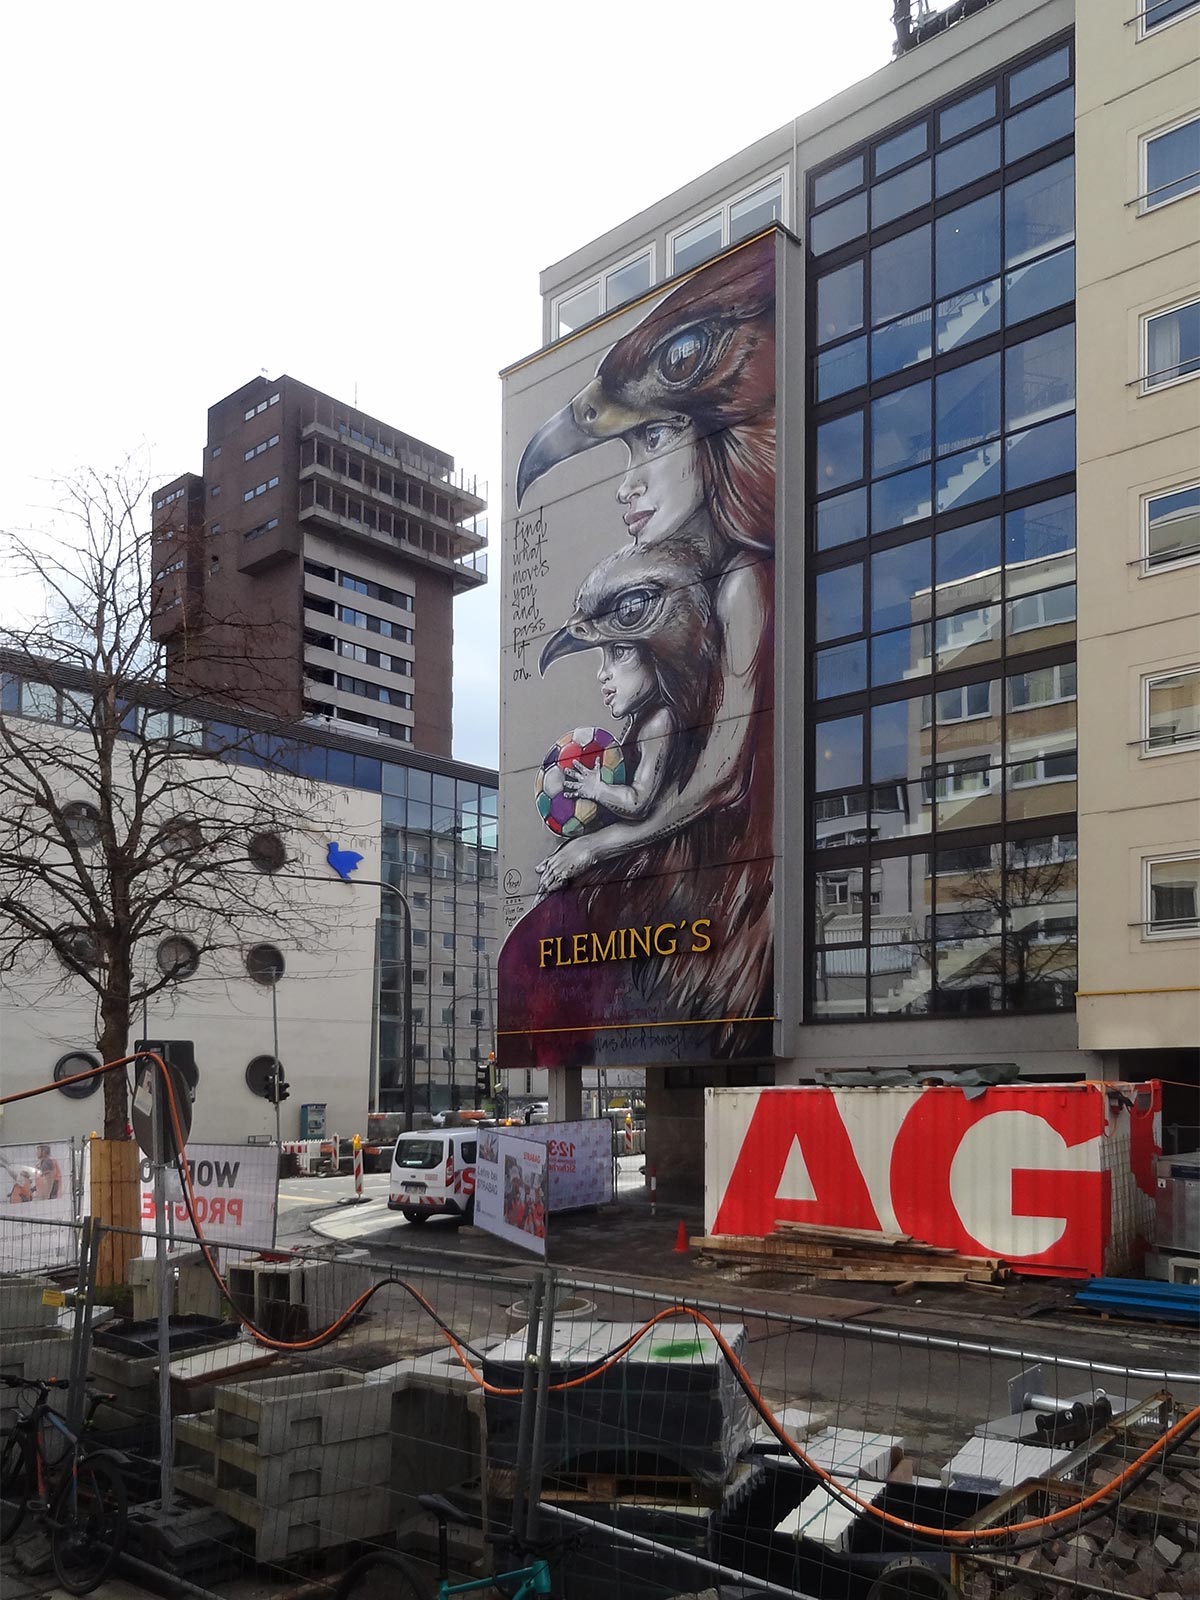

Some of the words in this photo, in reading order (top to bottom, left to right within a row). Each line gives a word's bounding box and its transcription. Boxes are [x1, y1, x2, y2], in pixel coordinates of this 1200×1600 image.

[513, 506, 548, 550] find
[512, 535, 549, 566] what
[512, 560, 550, 585] moves
[512, 582, 537, 607] you
[512, 597, 540, 621] and
[513, 618, 547, 653] pass
[517, 640, 531, 666] it
[512, 666, 532, 682] on.
[711, 1088, 1112, 1278] AG
